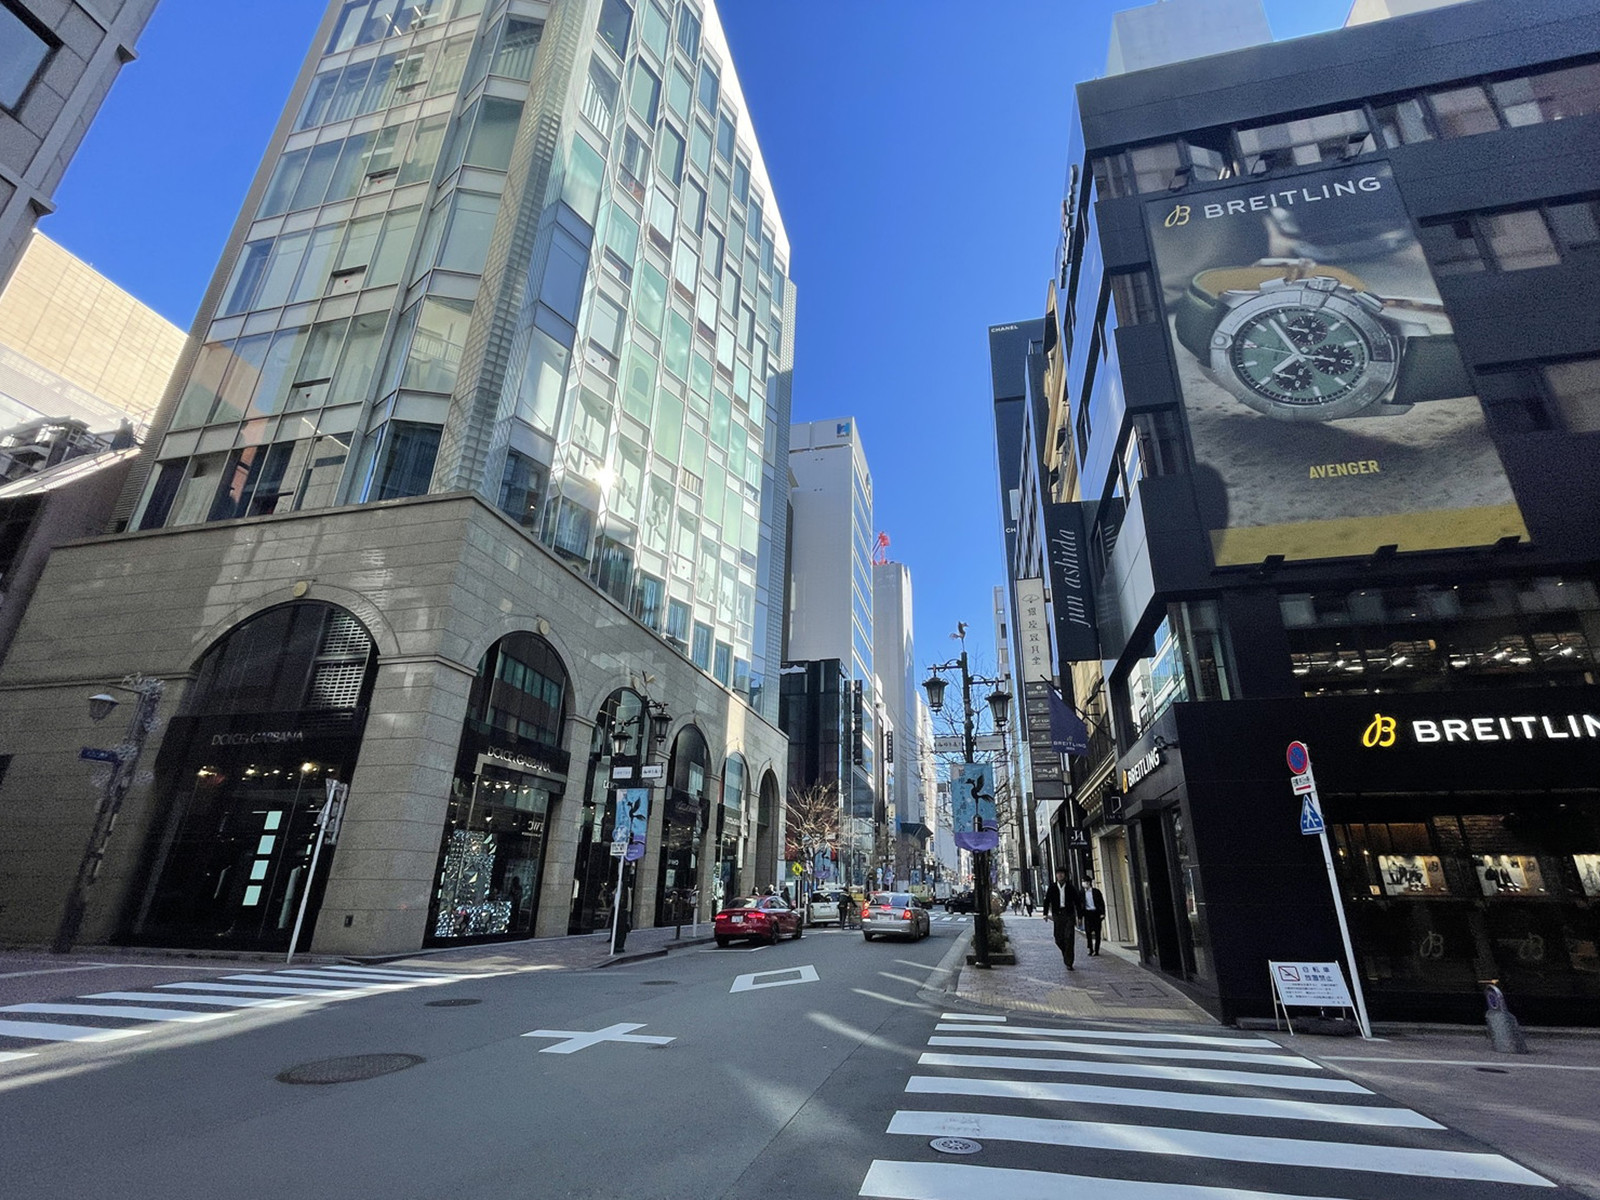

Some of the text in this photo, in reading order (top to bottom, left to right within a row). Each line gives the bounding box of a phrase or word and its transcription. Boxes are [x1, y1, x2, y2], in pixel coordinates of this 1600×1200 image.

[1203, 176, 1382, 219] BREITLING
[990, 324, 1019, 333] CHANEL
[1309, 460, 1380, 479] AVENGER
[1052, 529, 1091, 628] jun ashida
[1053, 740, 1087, 749] BREITLING
[1127, 746, 1160, 788] BREITLING
